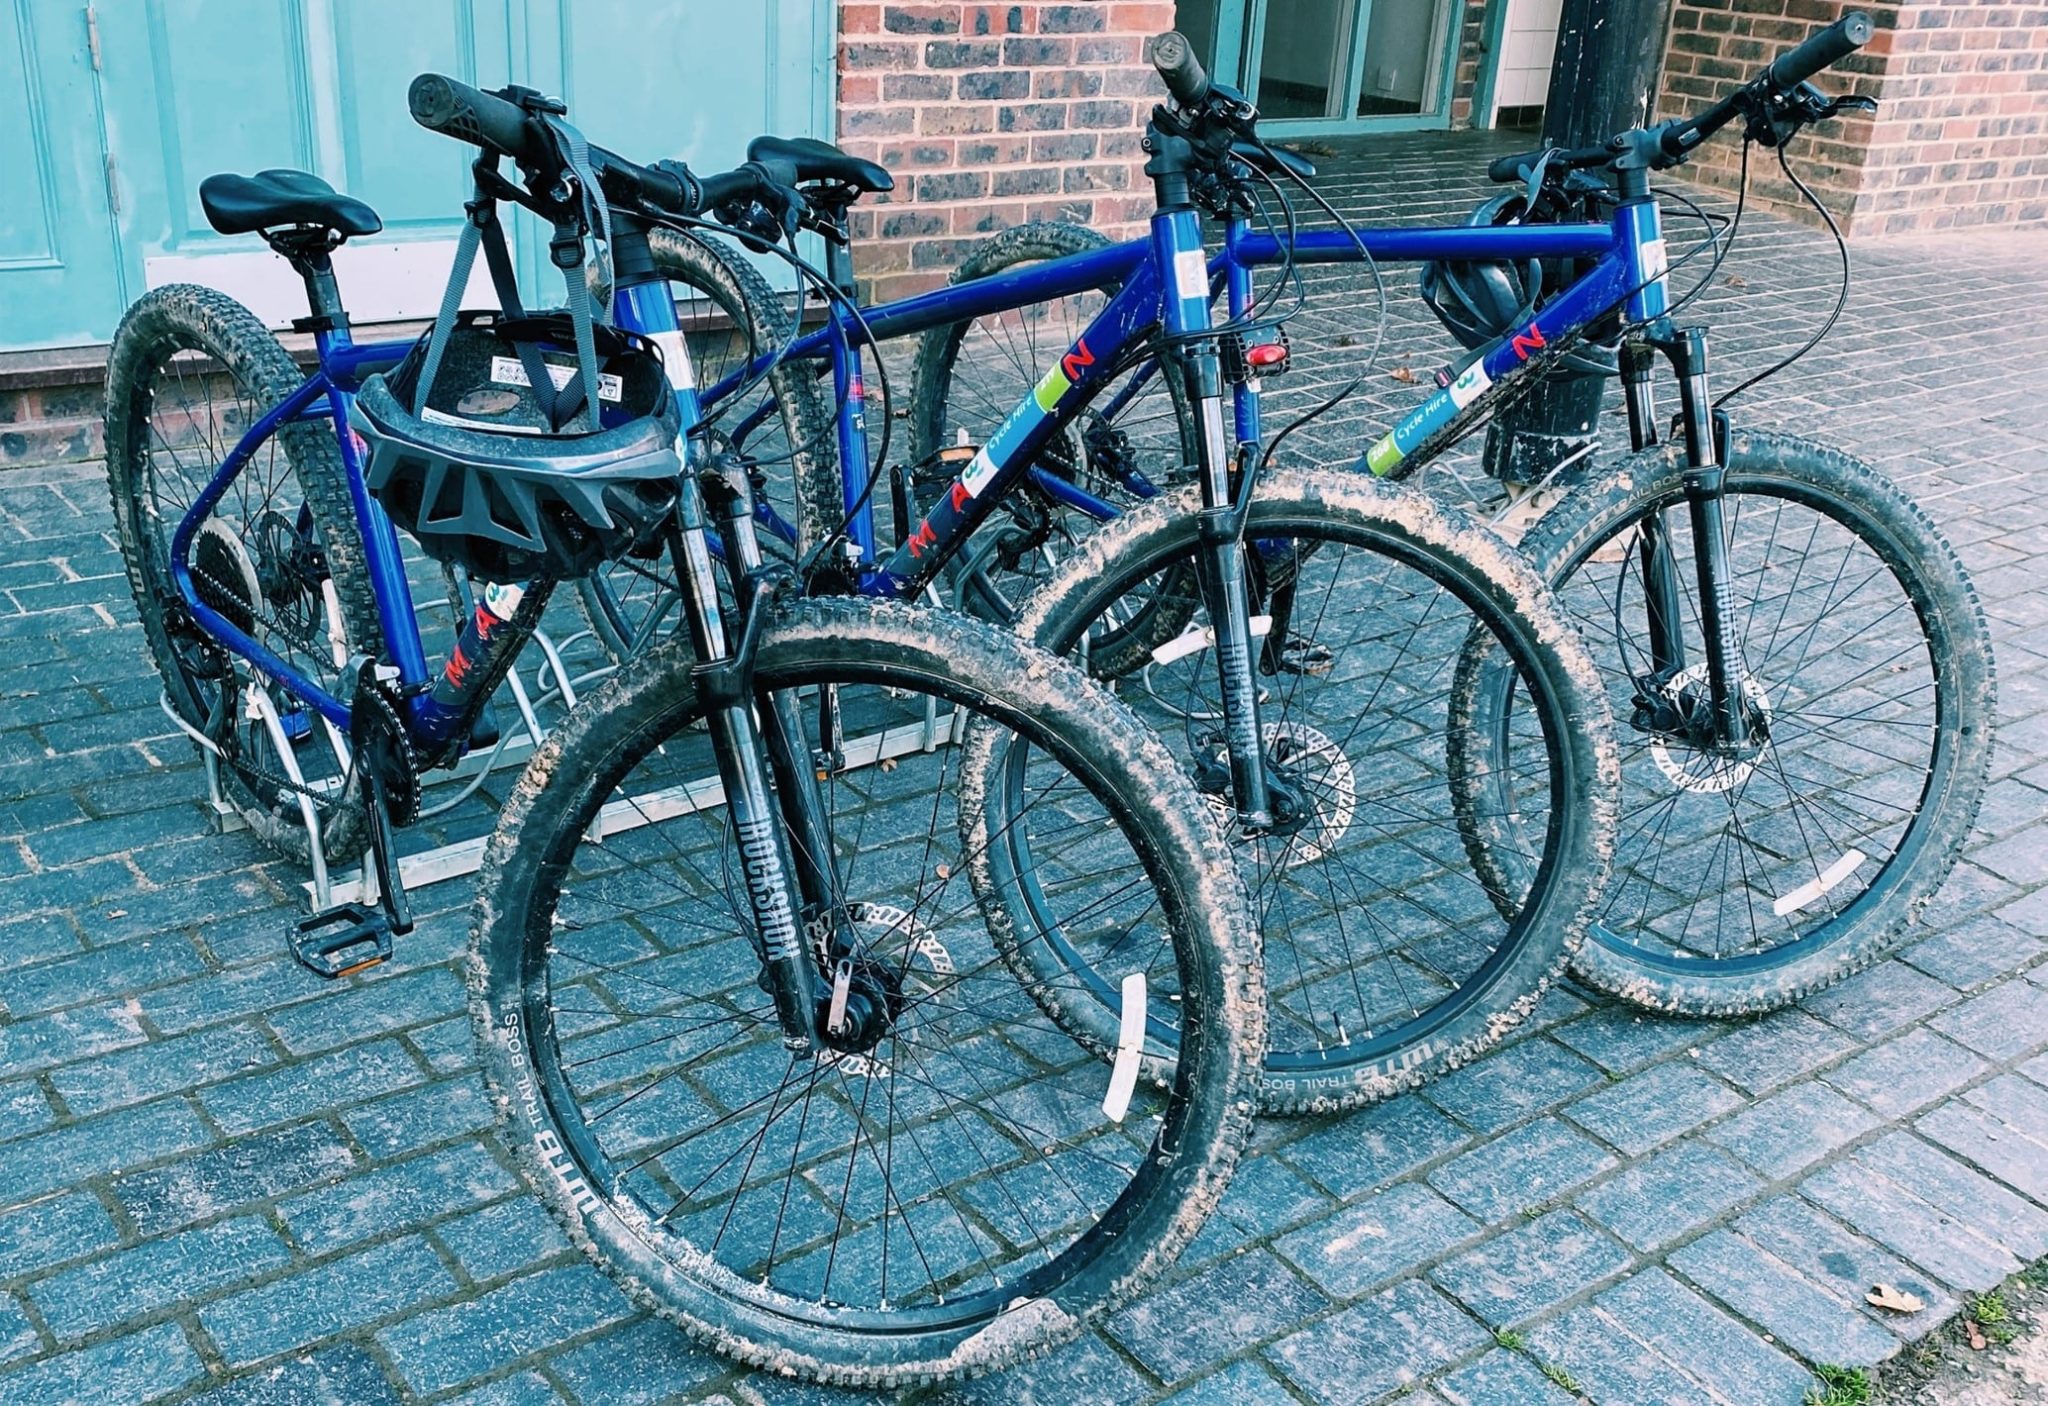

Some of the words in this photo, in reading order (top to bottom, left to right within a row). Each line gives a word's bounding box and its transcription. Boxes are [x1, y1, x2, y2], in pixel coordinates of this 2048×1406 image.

[989, 420, 1012, 449] Cycle
[1012, 396, 1032, 422] Hire
[1397, 413, 1424, 439] Cycle
[1425, 394, 1448, 416] Hire
[1653, 473, 1684, 490] BOS
[1715, 582, 1743, 684] ROCKSHOX
[1220, 644, 1259, 758] ROCKSHOX
[738, 819, 801, 961] ROCKSHOX
[505, 1013, 525, 1067] BOSS
[517, 1071, 544, 1128] TRAIL
[1302, 1074, 1349, 1091] TRAIL
[534, 1129, 600, 1215] WTB
